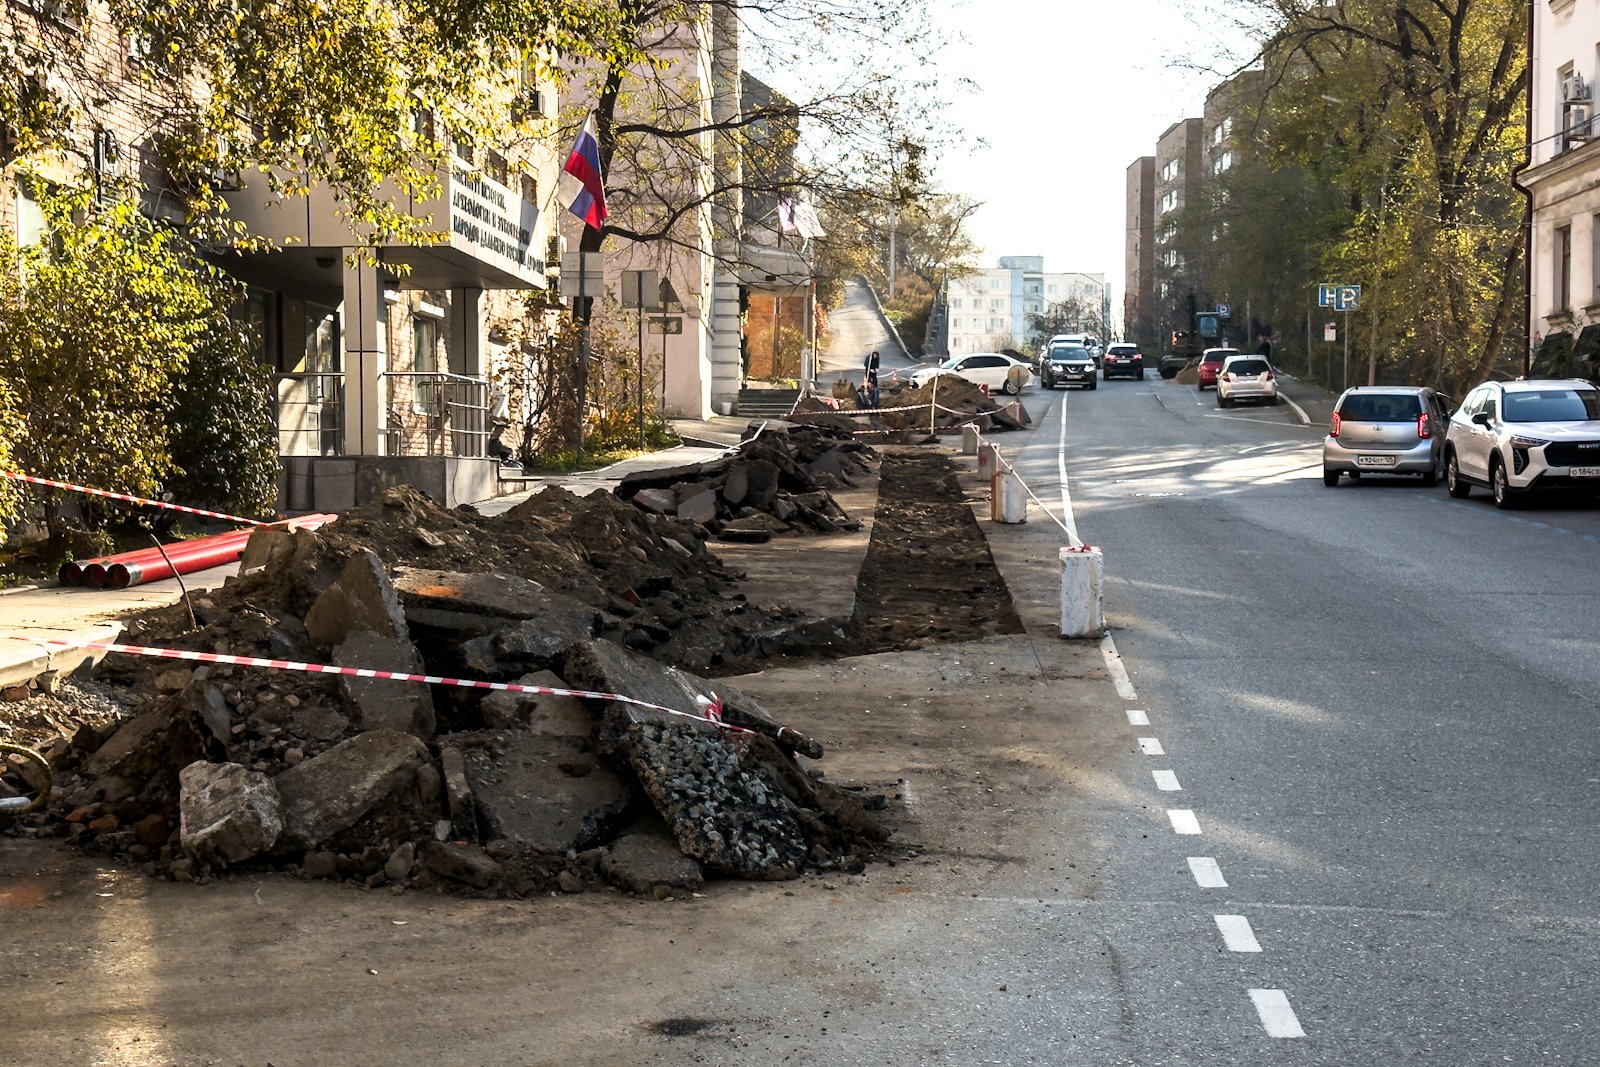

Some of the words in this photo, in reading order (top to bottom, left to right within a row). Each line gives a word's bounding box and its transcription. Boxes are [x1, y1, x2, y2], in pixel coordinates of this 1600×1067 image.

[453, 189, 490, 225] АРХЕОЛОГИИ
[492, 211, 497, 228] И
[453, 214, 480, 243] НАРОДОВ
[480, 229, 506, 256] ДАЛЬНЕГО
